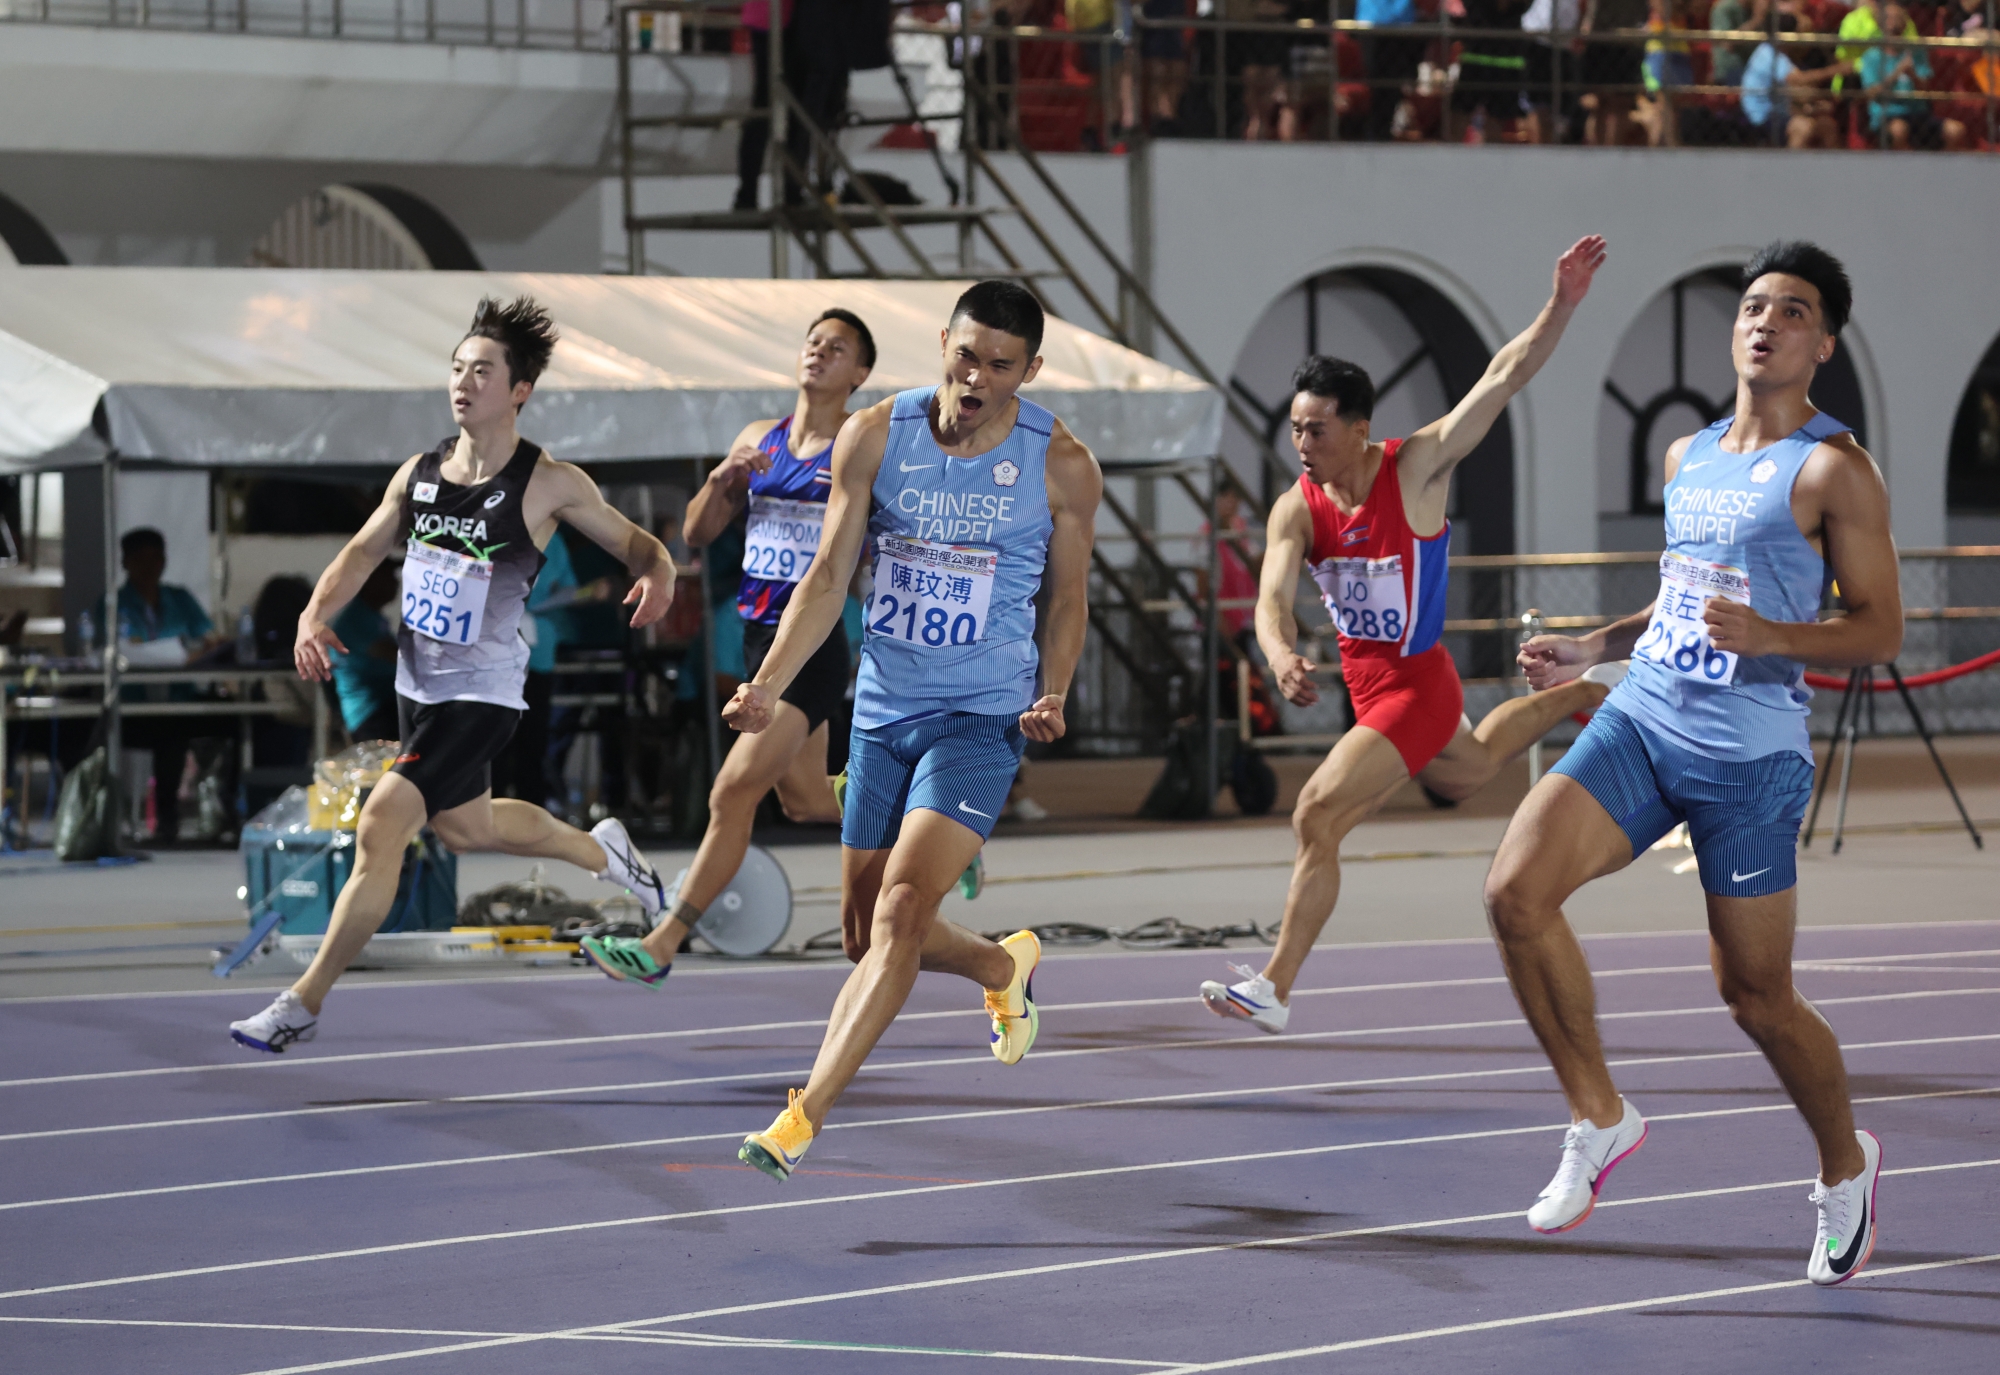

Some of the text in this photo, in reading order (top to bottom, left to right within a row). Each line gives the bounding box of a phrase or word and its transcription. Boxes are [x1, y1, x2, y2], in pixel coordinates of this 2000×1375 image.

[899, 488, 1015, 522] CHINESE
[1668, 486, 1764, 519] CHINESE
[413, 511, 488, 541] KOREA
[914, 516, 994, 543] TAIPEI
[1674, 513, 1737, 545] TAIPEI
[747, 545, 817, 578] 2297
[420, 570, 459, 599] SEO
[891, 562, 974, 605] 陳玟溥
[1344, 581, 1368, 602] JO
[403, 591, 472, 642] 2251
[872, 594, 977, 646] 2180
[1331, 602, 1403, 640] 2288
[1636, 620, 1728, 680] 2186
